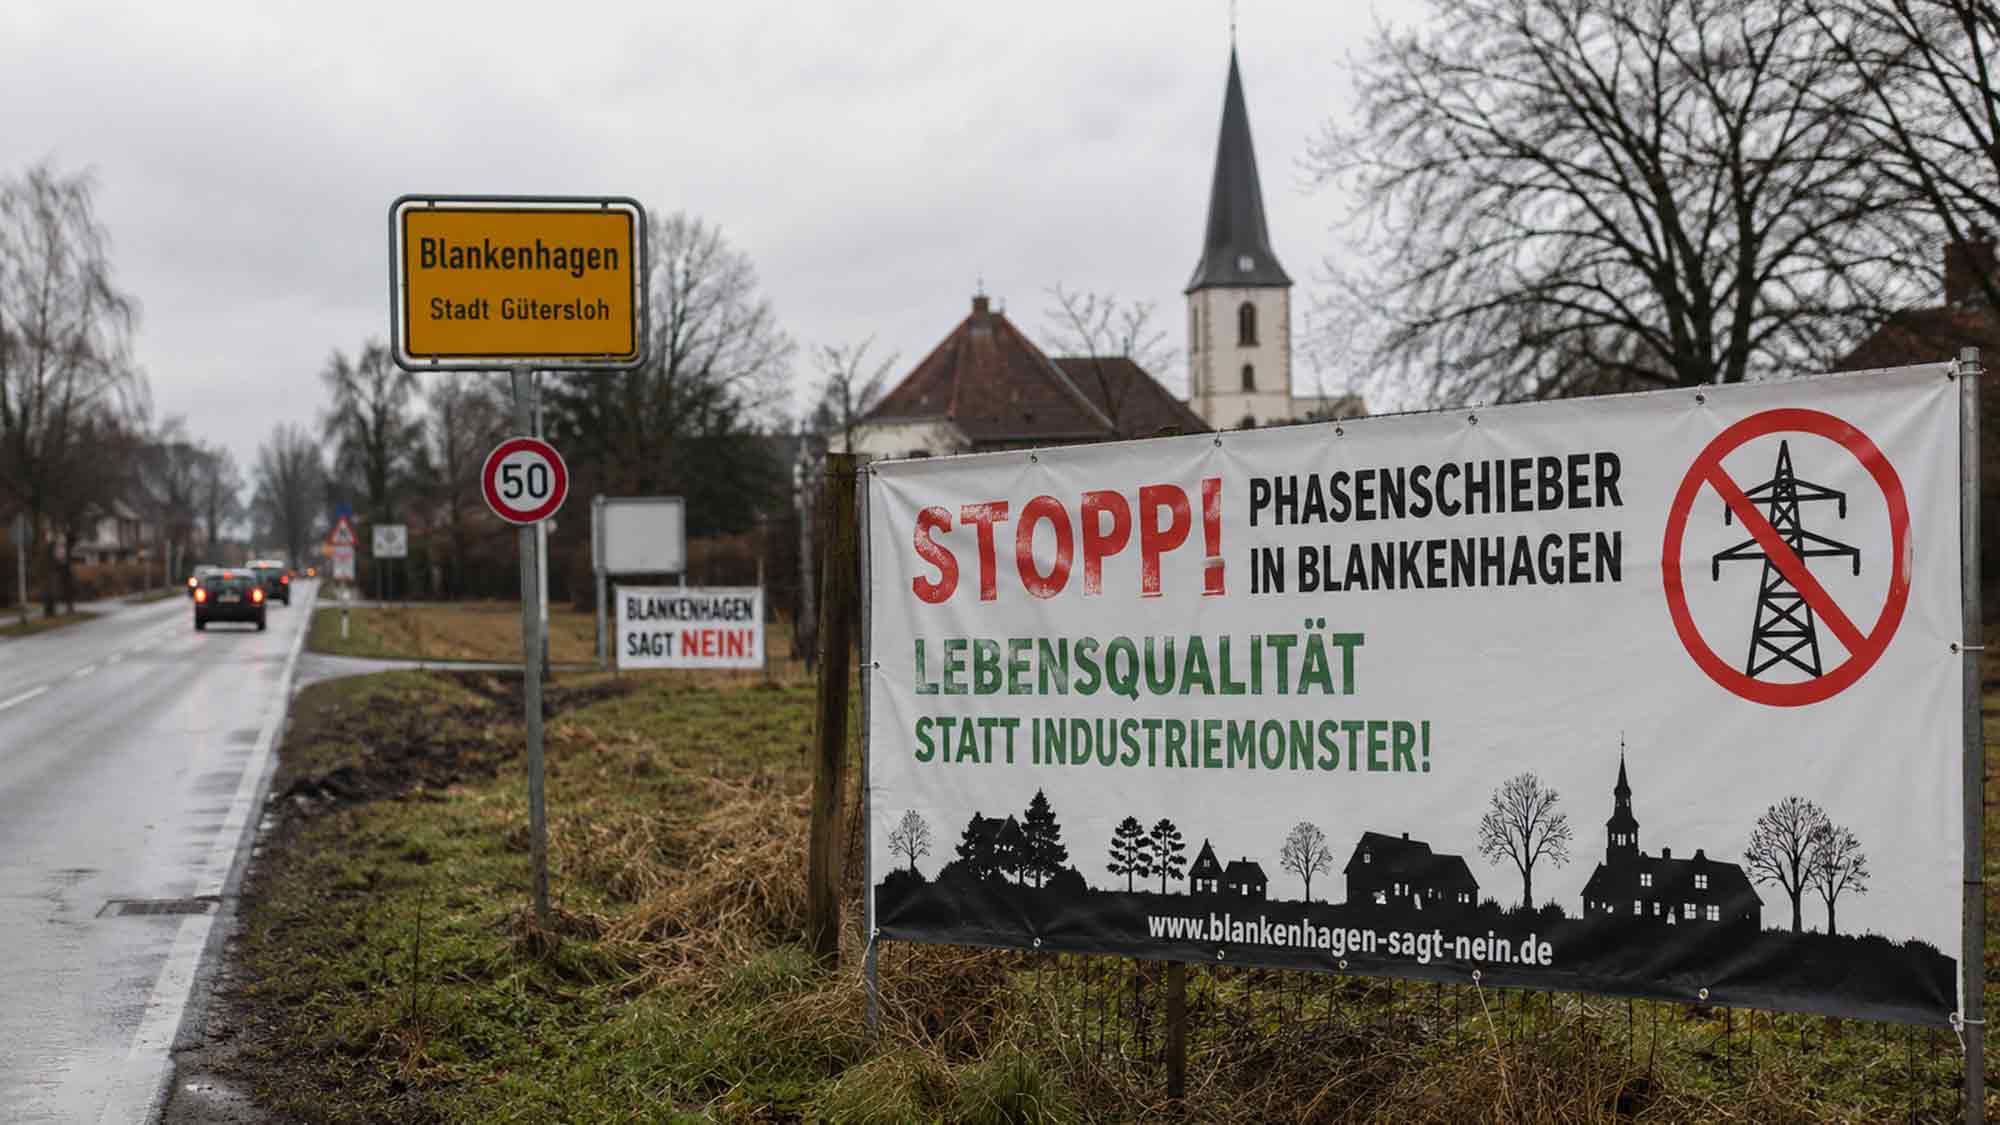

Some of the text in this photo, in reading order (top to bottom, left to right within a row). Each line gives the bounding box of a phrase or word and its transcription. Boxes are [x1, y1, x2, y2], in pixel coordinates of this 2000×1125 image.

[420, 238, 619, 278] Blankenhagen
[430, 297, 610, 321] Stadt Gütersloh
[502, 463, 549, 499] 50
[1249, 451, 1624, 527] PHASENSCHIEBER
[912, 478, 1226, 604] STOPP!
[1250, 530, 1622, 594] IN BLANKENHAGEN
[627, 597, 753, 621] BLANKENHAGEN
[627, 629, 754, 657] SAGT NEIN!
[914, 617, 1365, 702] LEBENSQUALITÄT
[914, 716, 1431, 773] STATT INDUSTRIEMONSTER!
[1147, 912, 1553, 967] www.blankenhagen-sagt-nein.de
